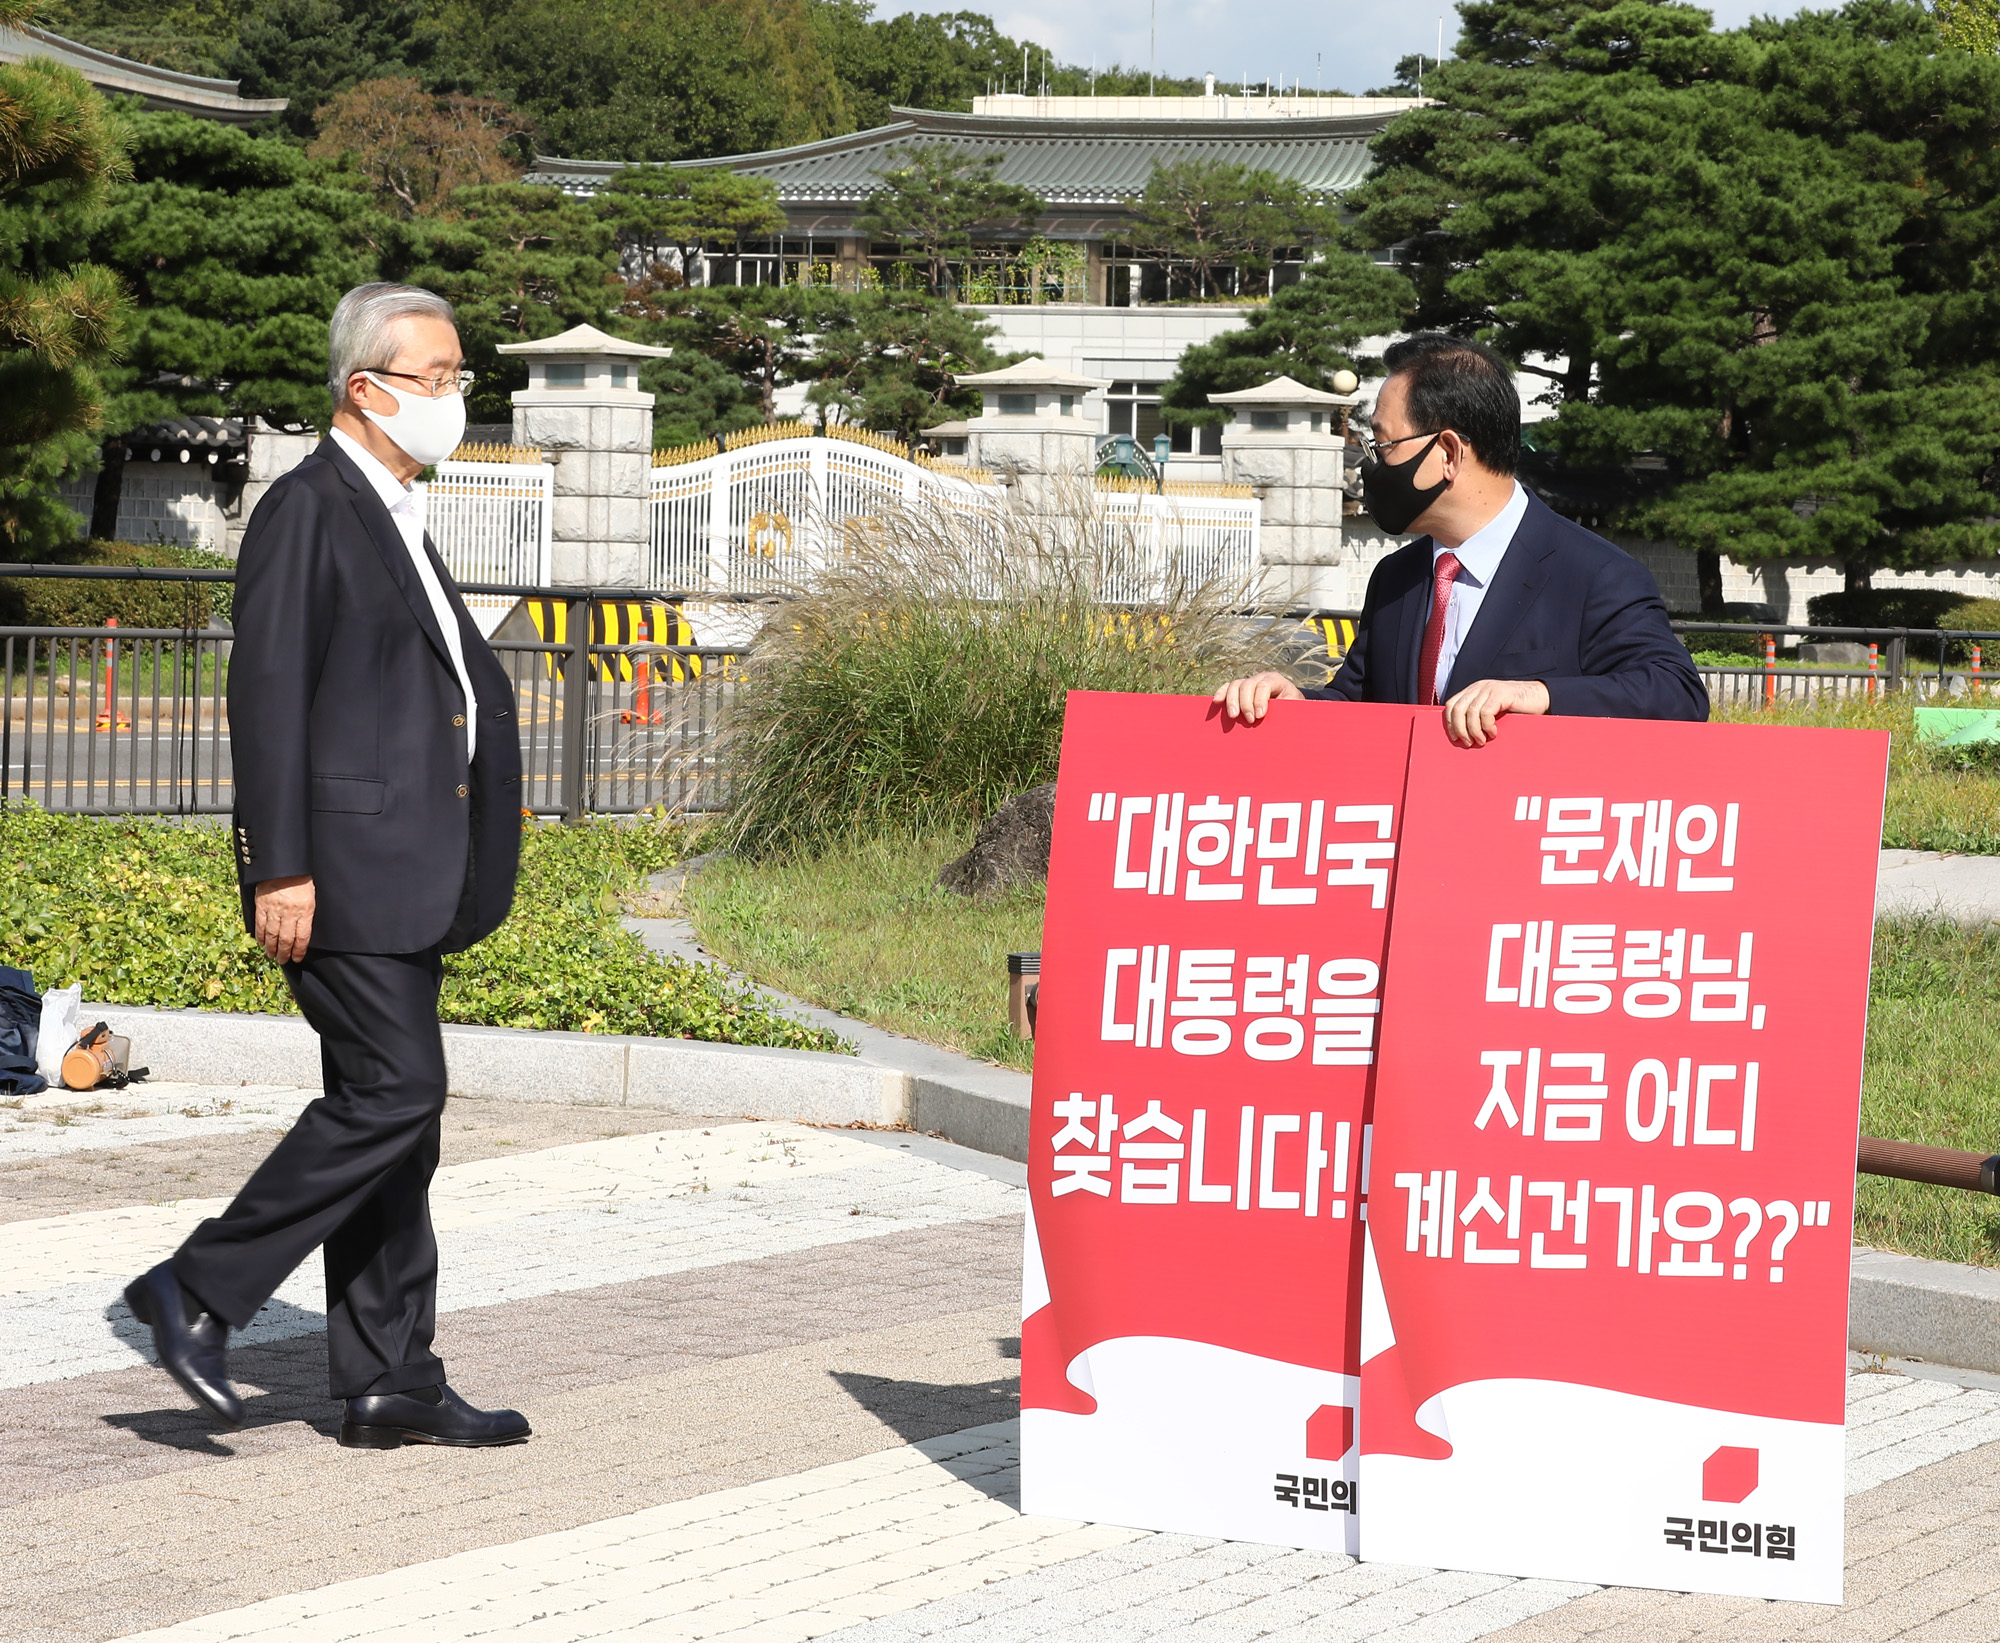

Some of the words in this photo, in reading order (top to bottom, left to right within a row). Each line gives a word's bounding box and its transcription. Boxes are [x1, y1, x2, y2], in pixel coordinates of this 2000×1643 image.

[1088, 792, 1395, 908] "대한민국
[1515, 796, 1740, 892] "문재인
[1101, 945, 1381, 1066] 대통령을
[1486, 921, 1767, 1030] 대통령님,
[1474, 1048, 1609, 1142] 지금
[1626, 1058, 1760, 1152] 어디
[1395, 1170, 1831, 1284] 계신건가요??"
[1274, 1473, 1357, 1515] 국민의
[1664, 1516, 1795, 1561] 국민의힘
